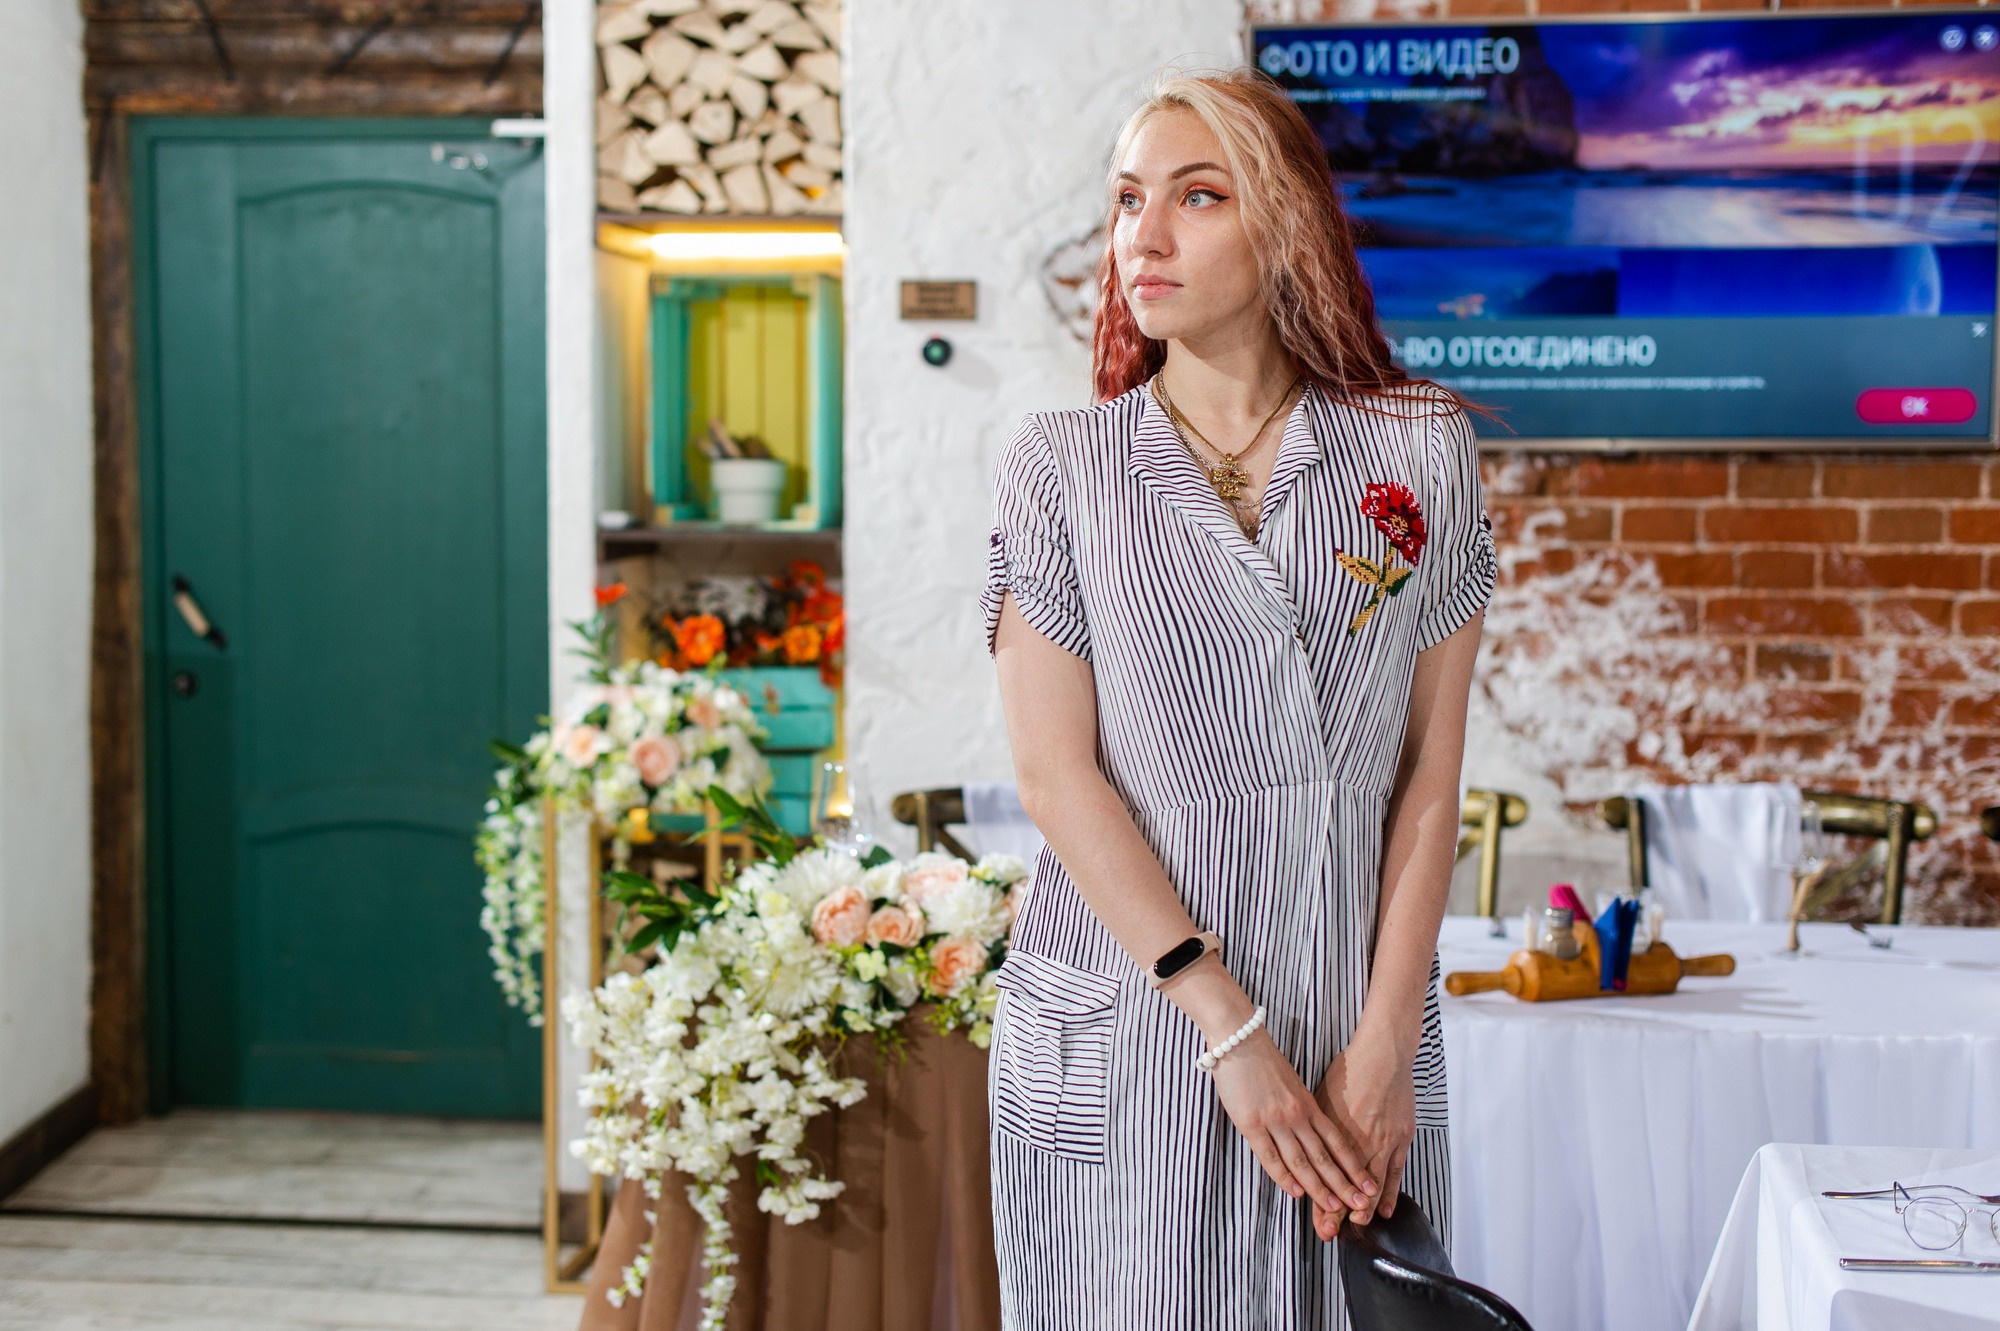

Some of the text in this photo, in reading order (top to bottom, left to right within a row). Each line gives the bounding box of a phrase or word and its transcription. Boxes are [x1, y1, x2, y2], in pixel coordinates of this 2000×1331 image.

[1260, 37, 1520, 80] ФОТО И ВИДЕО
[1447, 334, 1657, 372] ОТСОЕДИНЕНО
